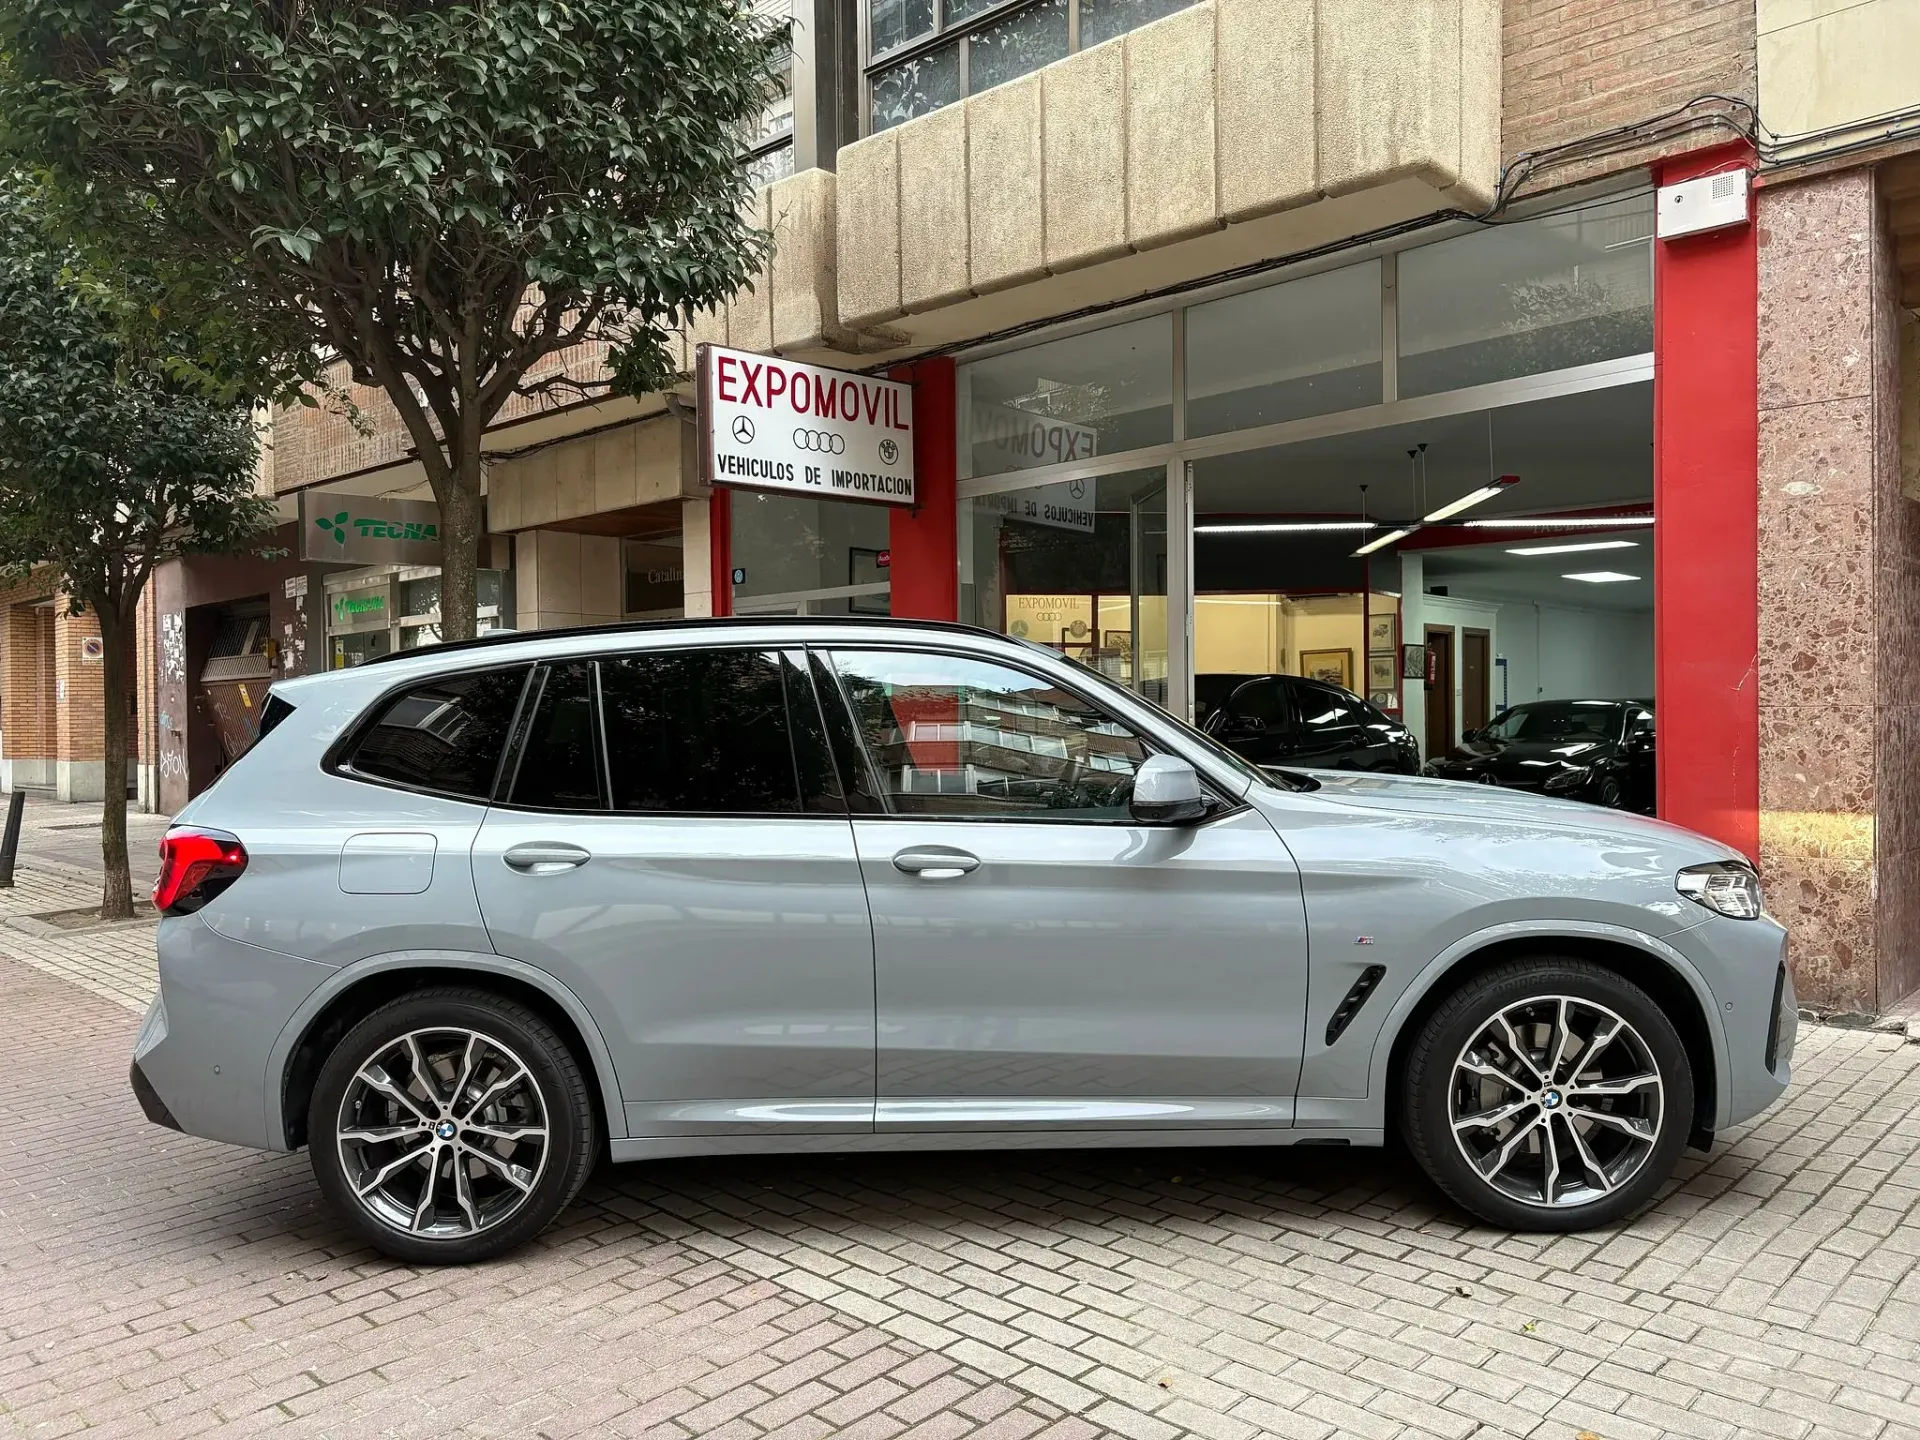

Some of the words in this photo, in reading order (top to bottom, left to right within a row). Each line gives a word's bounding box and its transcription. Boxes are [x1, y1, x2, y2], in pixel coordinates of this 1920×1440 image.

[718, 356, 909, 431] EXPOMOVIL
[717, 453, 795, 482] VEHICULOS
[804, 466, 822, 486] DE
[831, 469, 912, 496] IMPORTACION
[647, 566, 684, 584] Catalin
[1018, 597, 1080, 609] EXPOMOVIL
